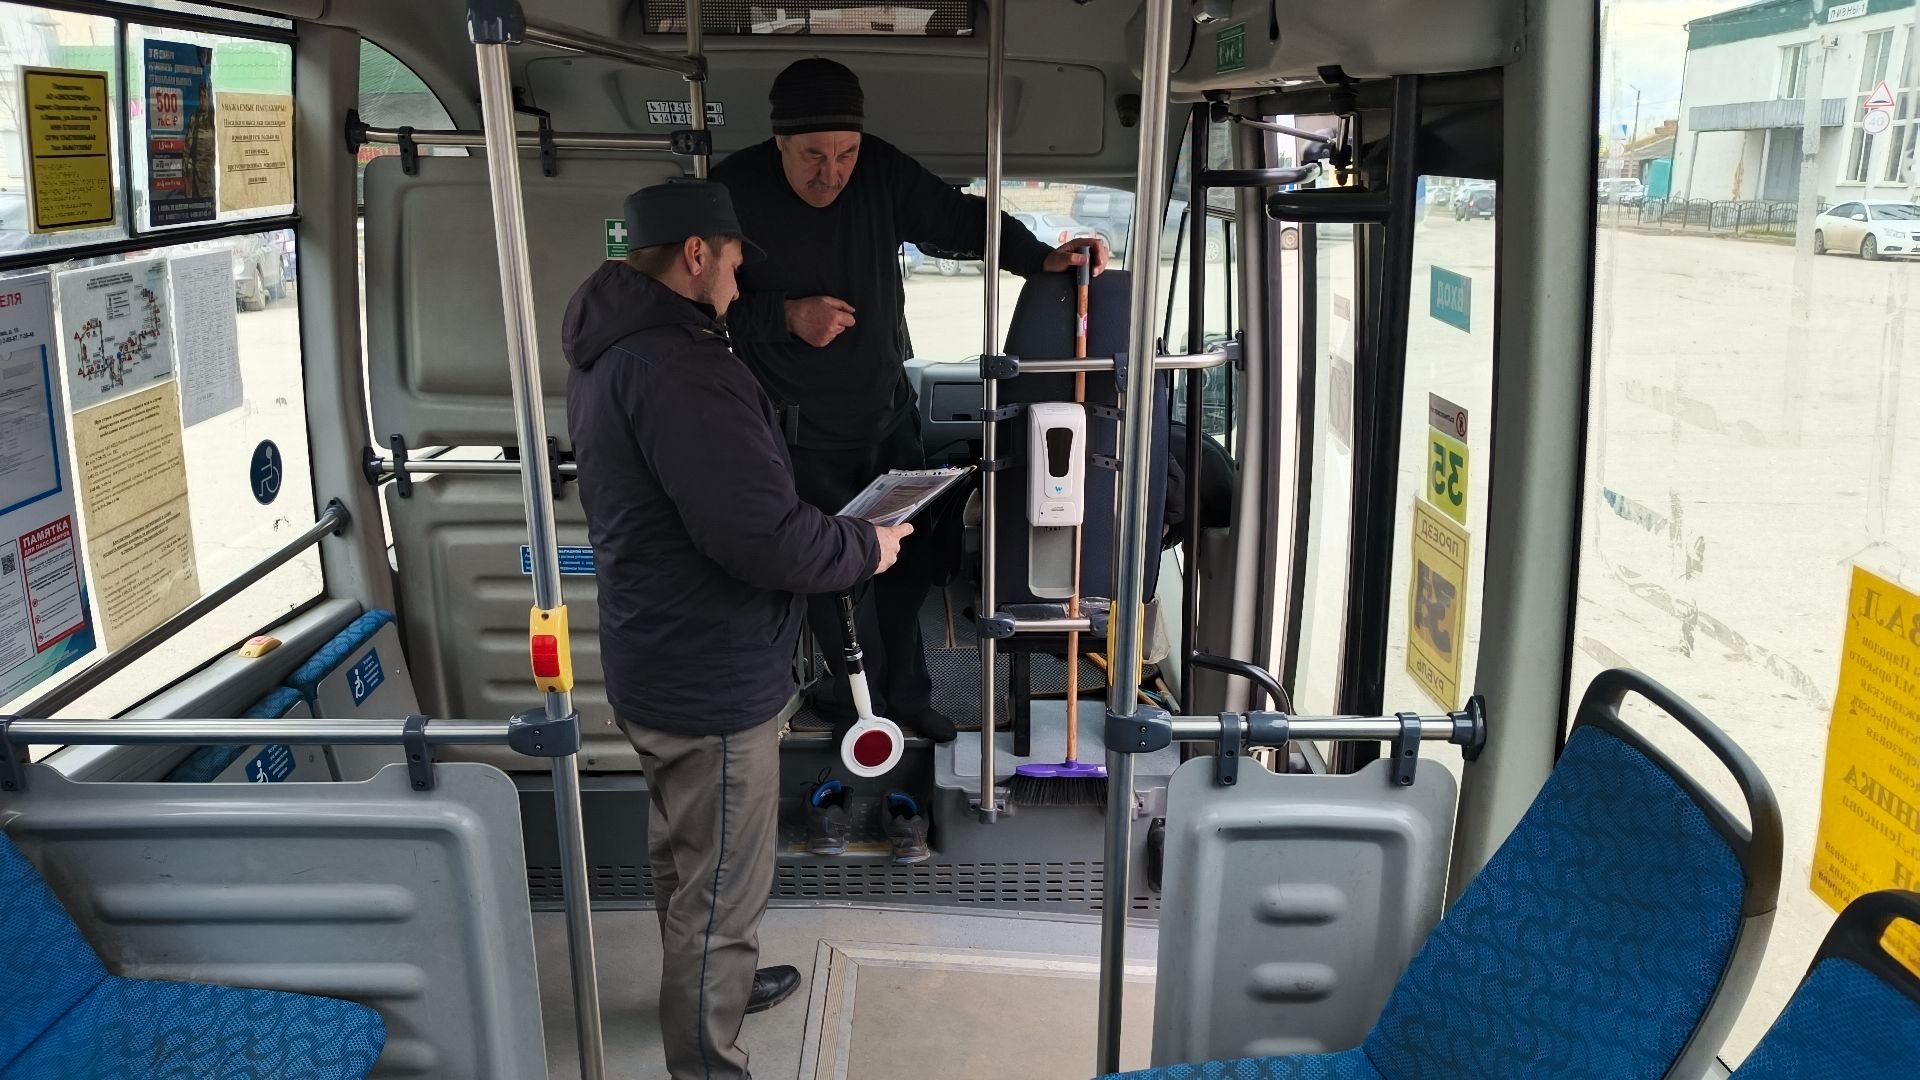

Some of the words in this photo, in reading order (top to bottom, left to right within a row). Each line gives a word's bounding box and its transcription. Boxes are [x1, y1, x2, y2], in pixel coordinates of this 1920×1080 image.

[155, 92, 178, 113] 500
[658, 102, 667, 111] 17
[660, 114, 670, 122] 14
[1868, 116, 1885, 126] 40
[22, 520, 69, 548] ПАМЯТКА
